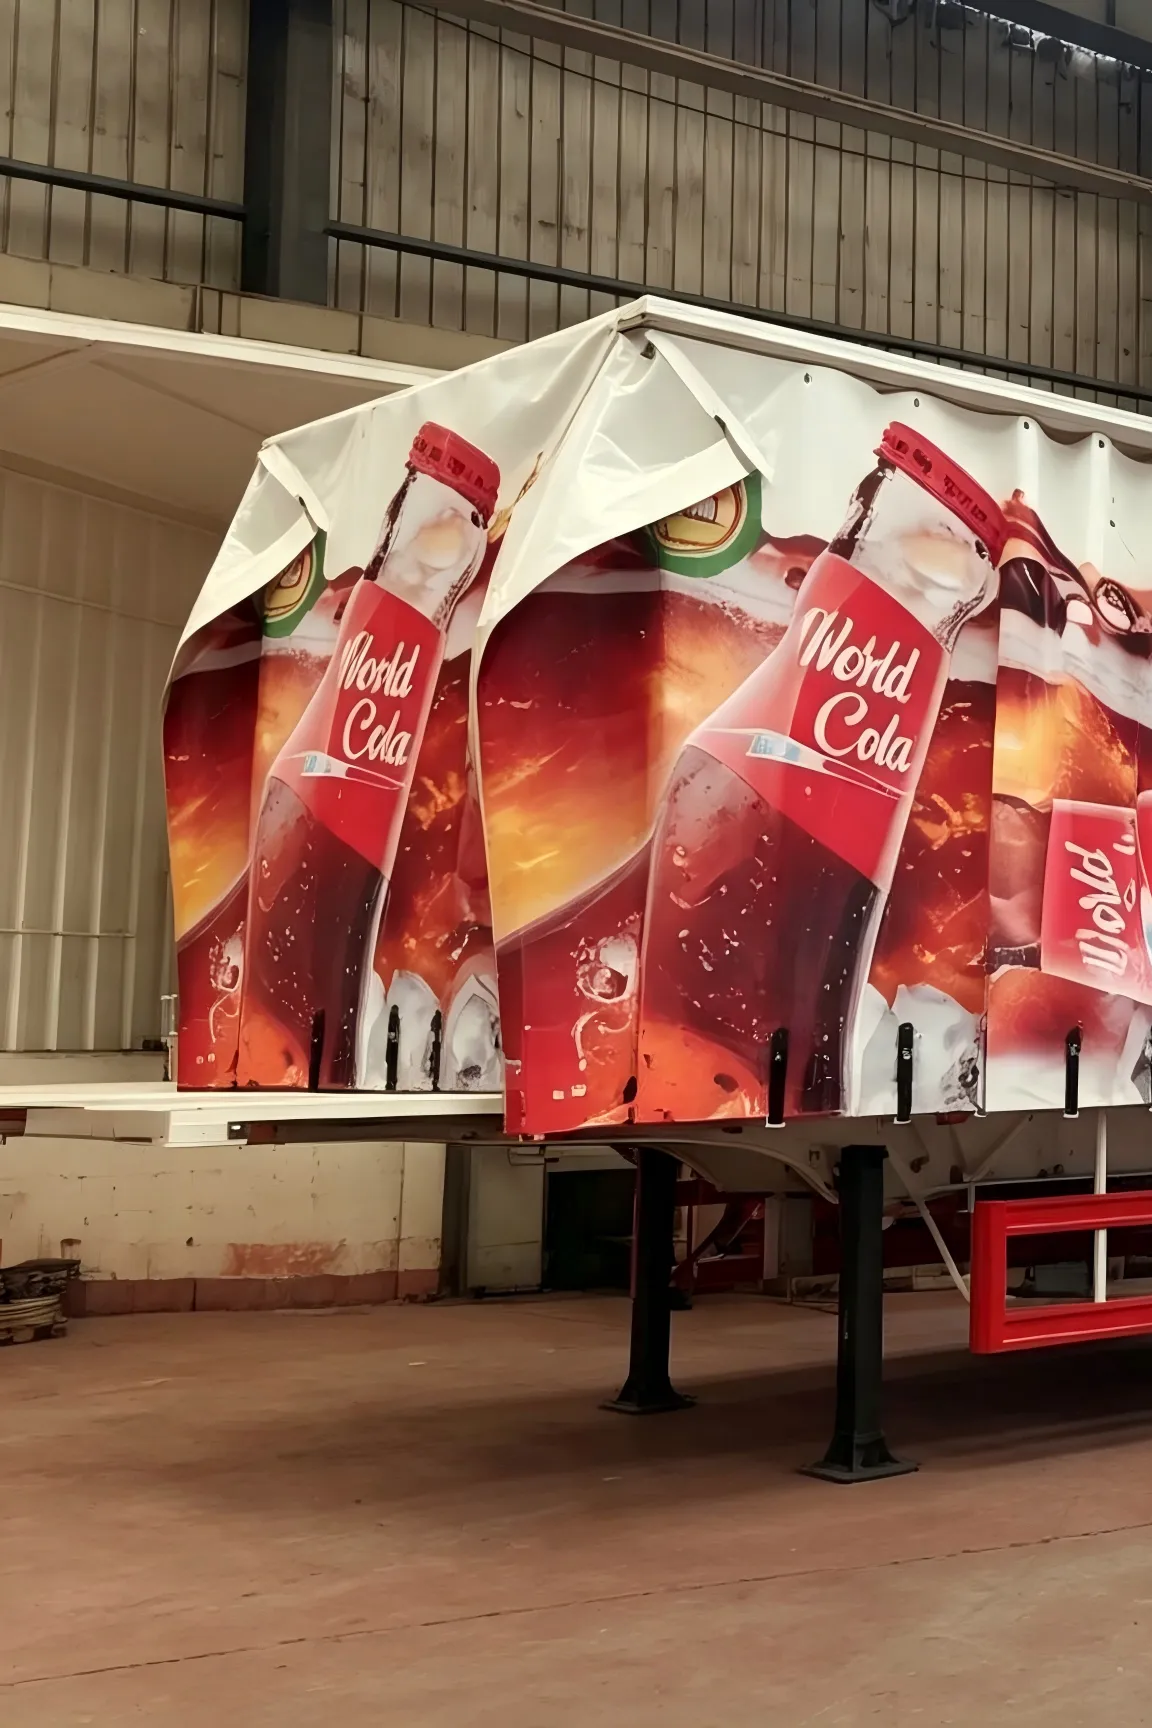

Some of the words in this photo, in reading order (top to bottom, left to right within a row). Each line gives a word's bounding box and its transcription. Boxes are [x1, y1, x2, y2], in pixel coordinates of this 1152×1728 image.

[337, 631, 420, 698] World
[799, 607, 921, 704] World
[814, 692, 913, 774] Cola
[1065, 840, 1131, 977] World
